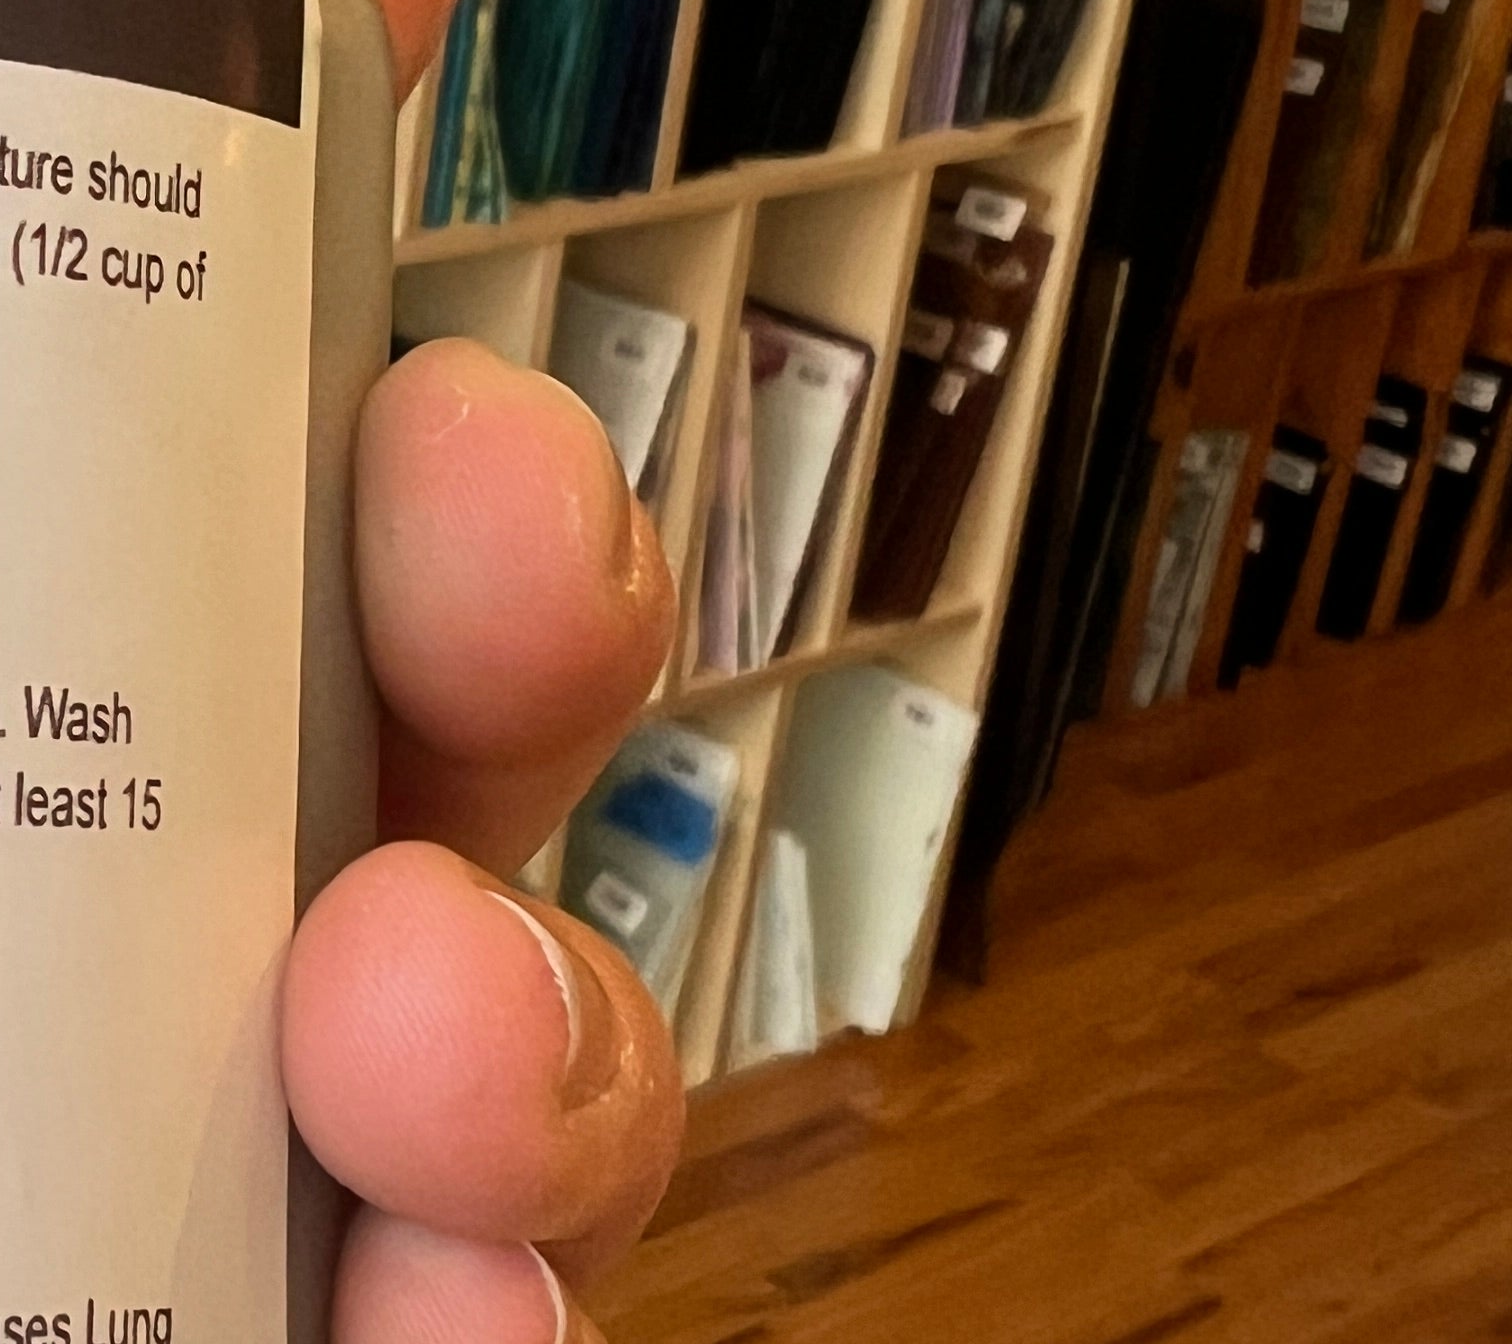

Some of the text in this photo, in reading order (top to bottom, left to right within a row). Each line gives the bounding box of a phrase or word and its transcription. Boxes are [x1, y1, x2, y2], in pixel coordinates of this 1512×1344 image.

[88, 150, 202, 218] should
[13, 220, 88, 286] (1/2
[102, 247, 164, 304] cup
[176, 251, 207, 301] of
[24, 686, 132, 744] Wash
[15, 771, 107, 830] least
[122, 777, 161, 831] 15
